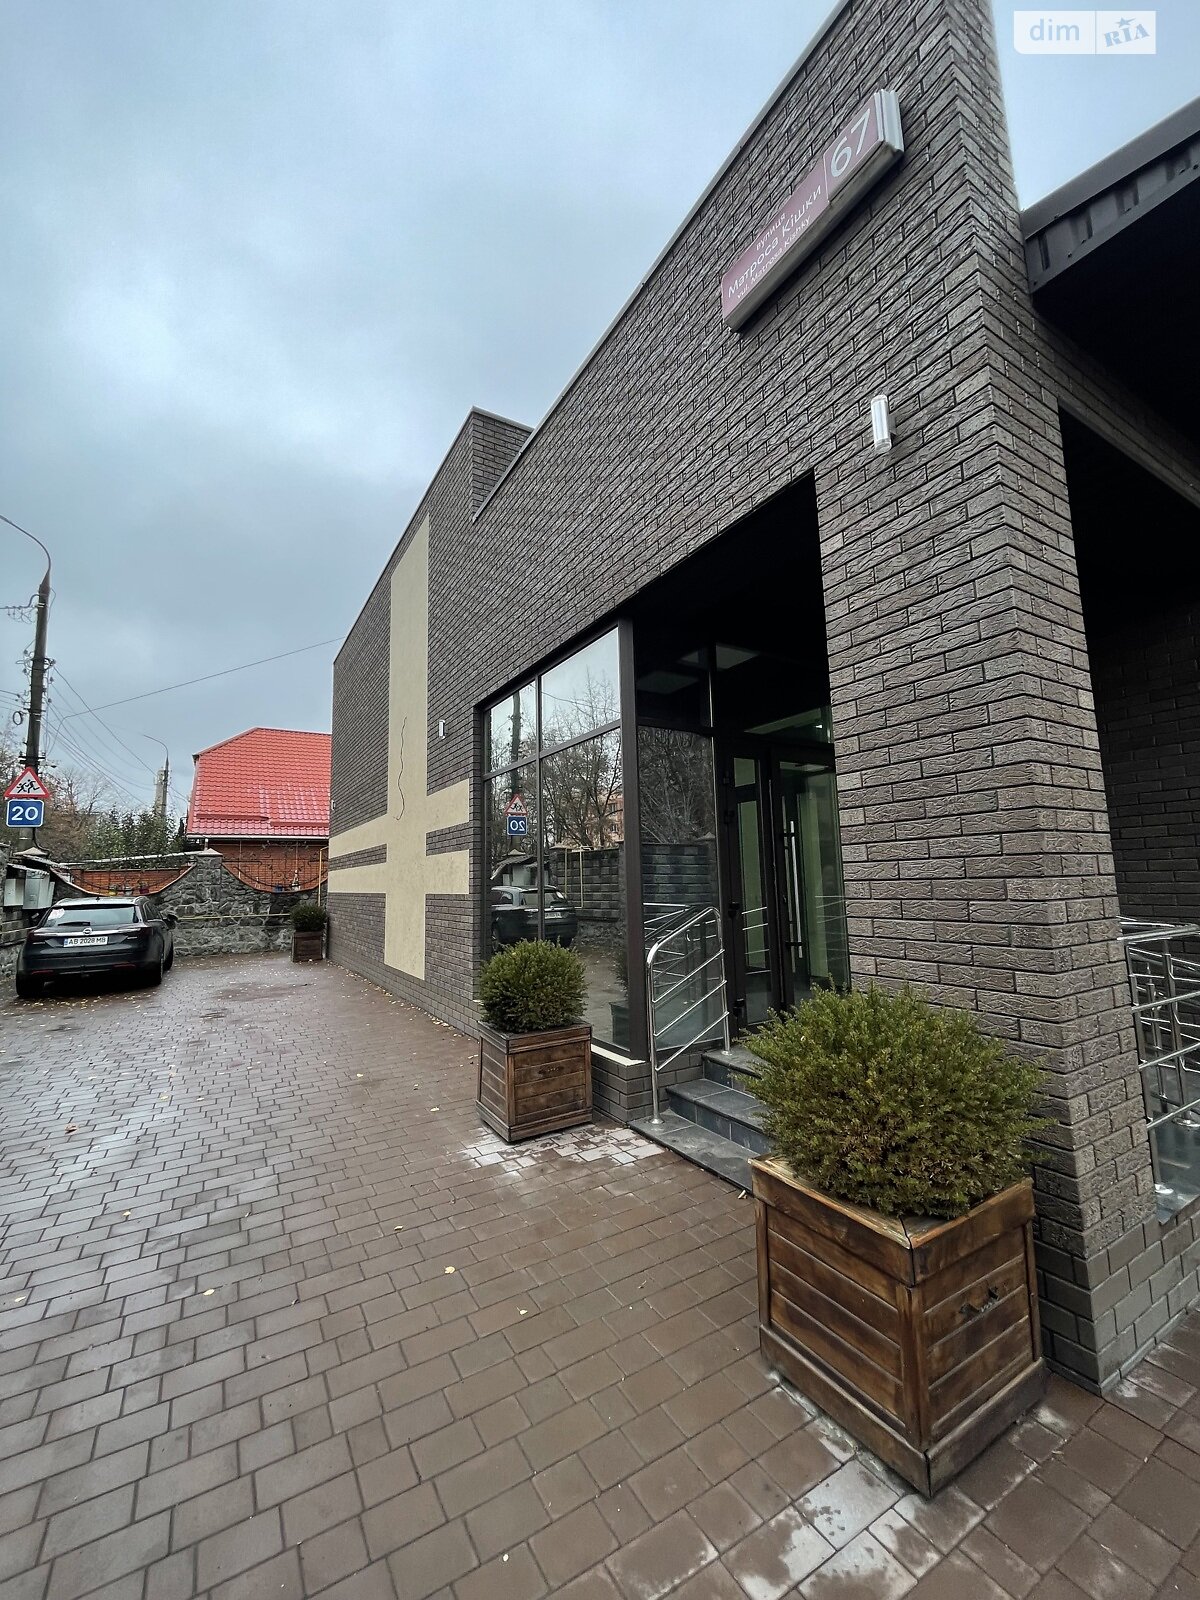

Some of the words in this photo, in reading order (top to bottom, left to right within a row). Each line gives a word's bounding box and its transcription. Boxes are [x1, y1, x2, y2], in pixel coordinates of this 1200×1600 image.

[830, 107, 871, 178] 67
[728, 237, 779, 298] Матроса
[782, 185, 821, 237] Кішки
[756, 213, 786, 251] вулиця
[11, 805, 39, 822] 20
